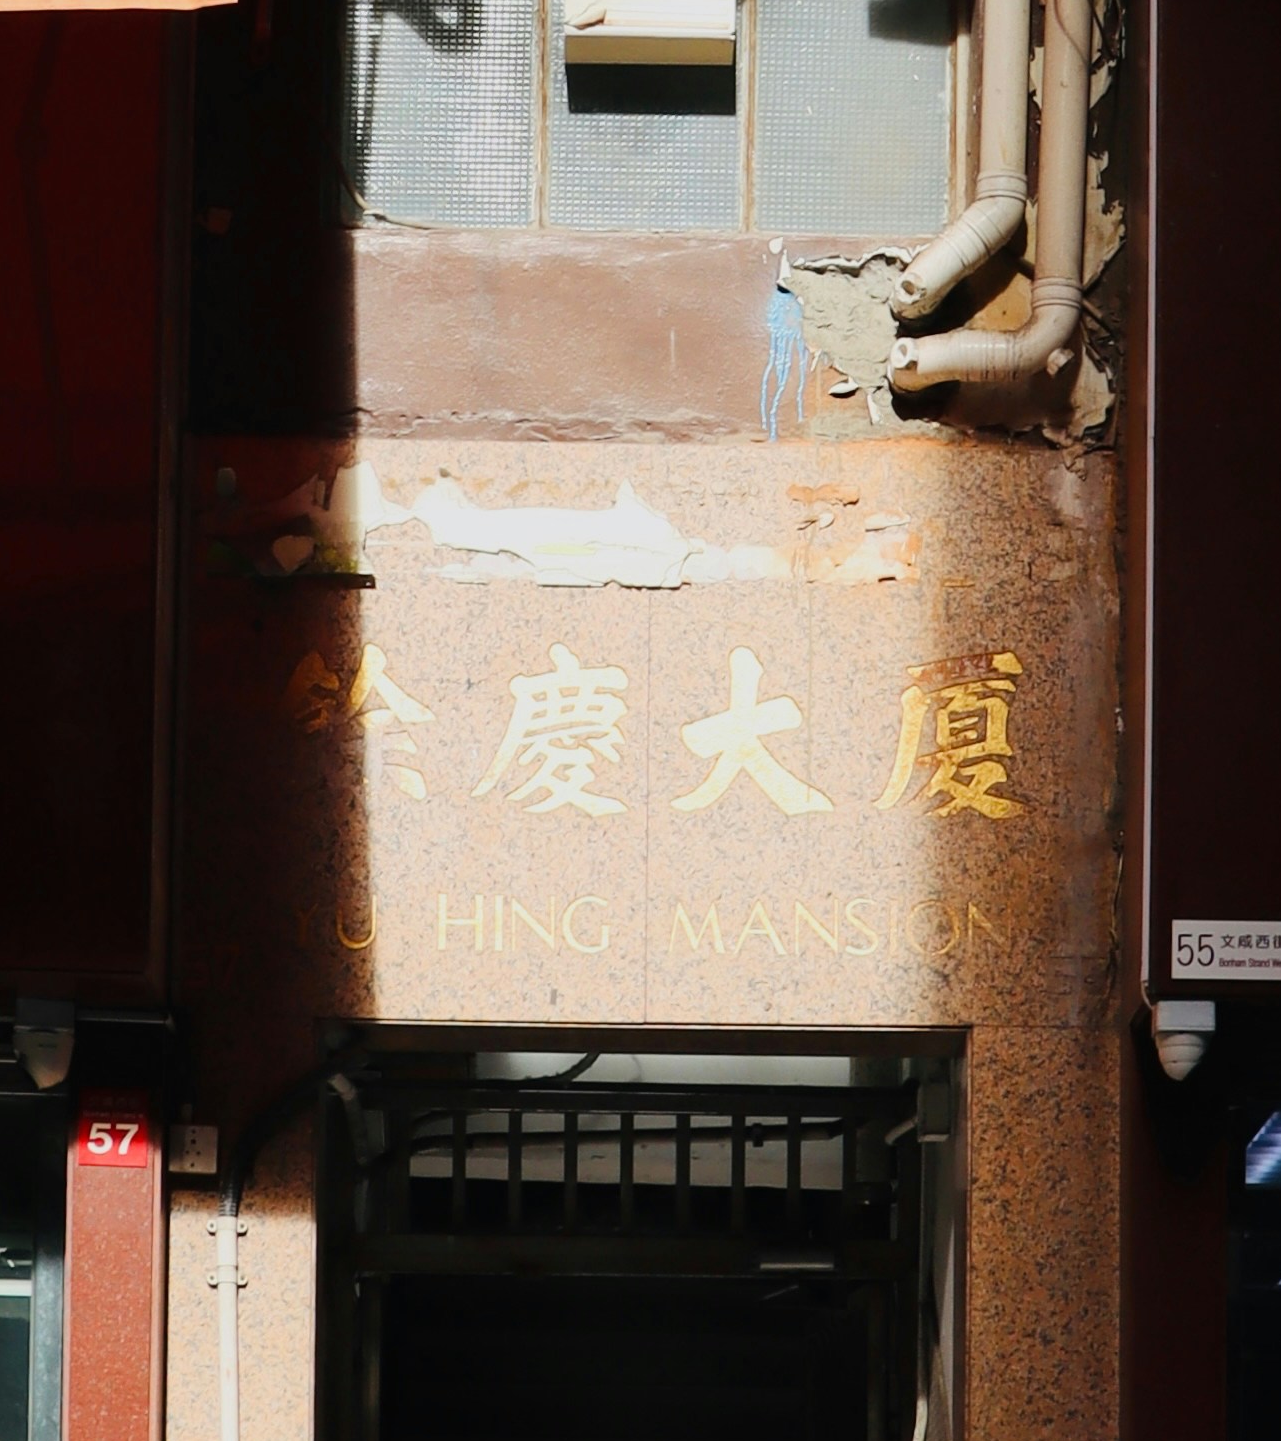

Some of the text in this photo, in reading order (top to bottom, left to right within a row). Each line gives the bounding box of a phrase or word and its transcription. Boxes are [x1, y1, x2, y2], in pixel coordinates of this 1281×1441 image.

[437, 892, 613, 956] HING
[669, 895, 1017, 959] MANSION
[1176, 933, 1215, 967] 55
[1218, 957, 1246, 968] Bonham
[1248, 958, 1271, 968] Strand
[87, 1122, 140, 1155] 57
